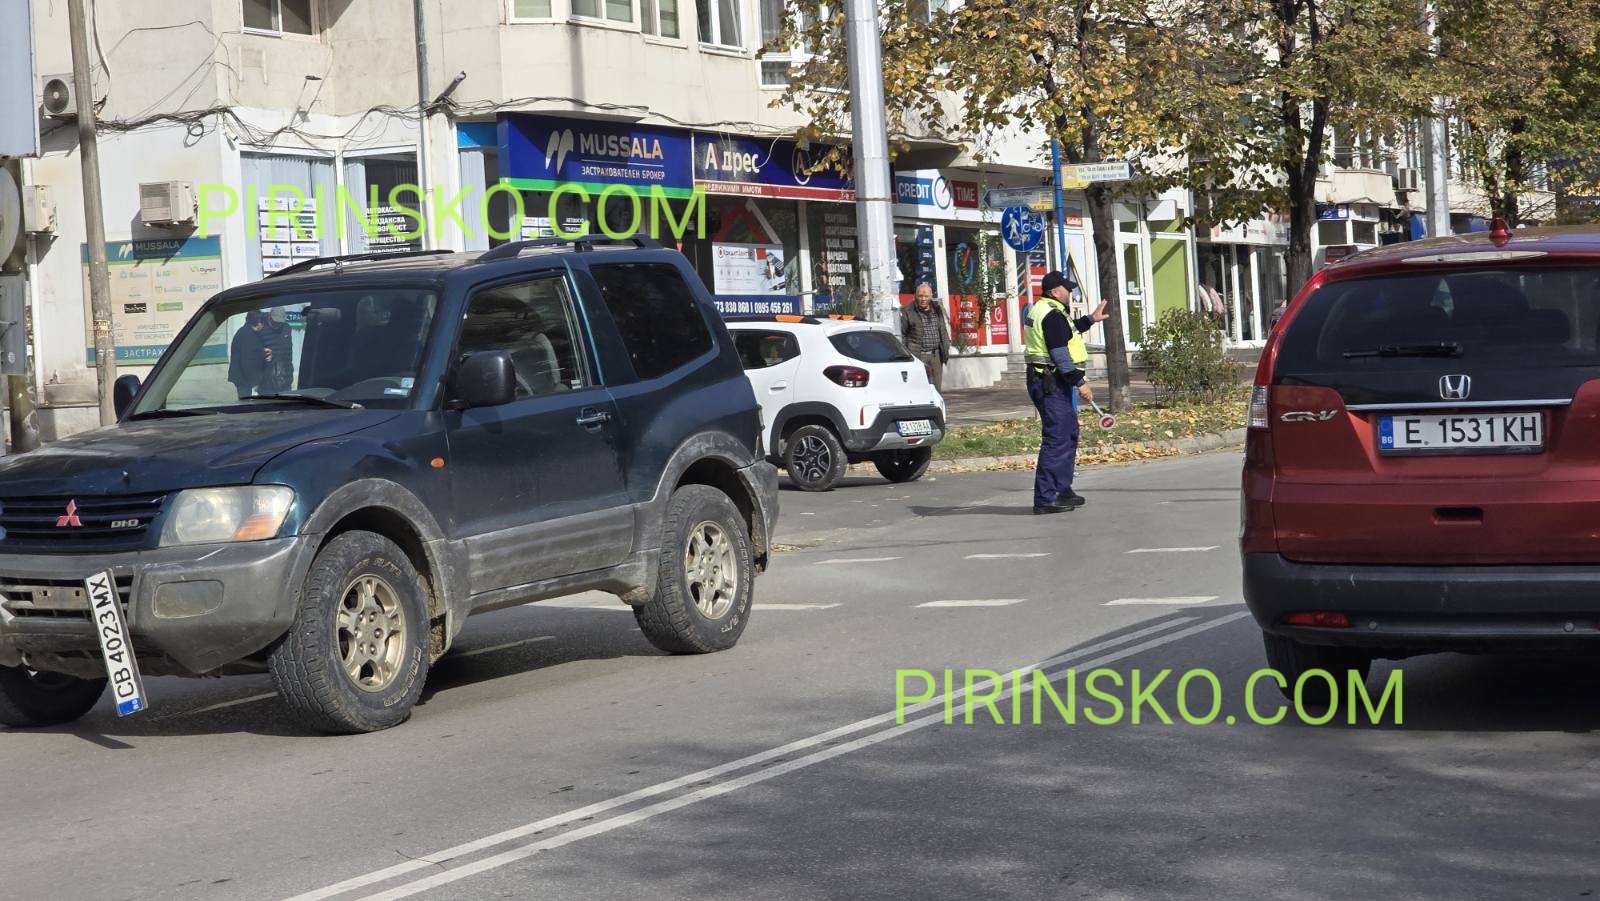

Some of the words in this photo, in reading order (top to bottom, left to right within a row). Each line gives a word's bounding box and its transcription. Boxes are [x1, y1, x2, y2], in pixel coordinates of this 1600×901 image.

[579, 132, 664, 160] MUSSALA
[581, 166, 640, 179] ЗАСТРАХОВАТЕЛЕН
[642, 170, 665, 180] БРОКЕР
[742, 186, 763, 195] ИМОТИ
[898, 182, 930, 199] CREDIT
[955, 186, 976, 202] TIME
[135, 240, 180, 251] MUSSALA
[725, 301, 737, 313] 830
[754, 301, 769, 314] 0895
[782, 302, 793, 314] 261
[124, 348, 166, 358] ЗАСТРАХ
[1381, 435, 1393, 445] BG
[90, 577, 113, 610] MX
[99, 609, 126, 665] 4023
[113, 667, 135, 699] CB
